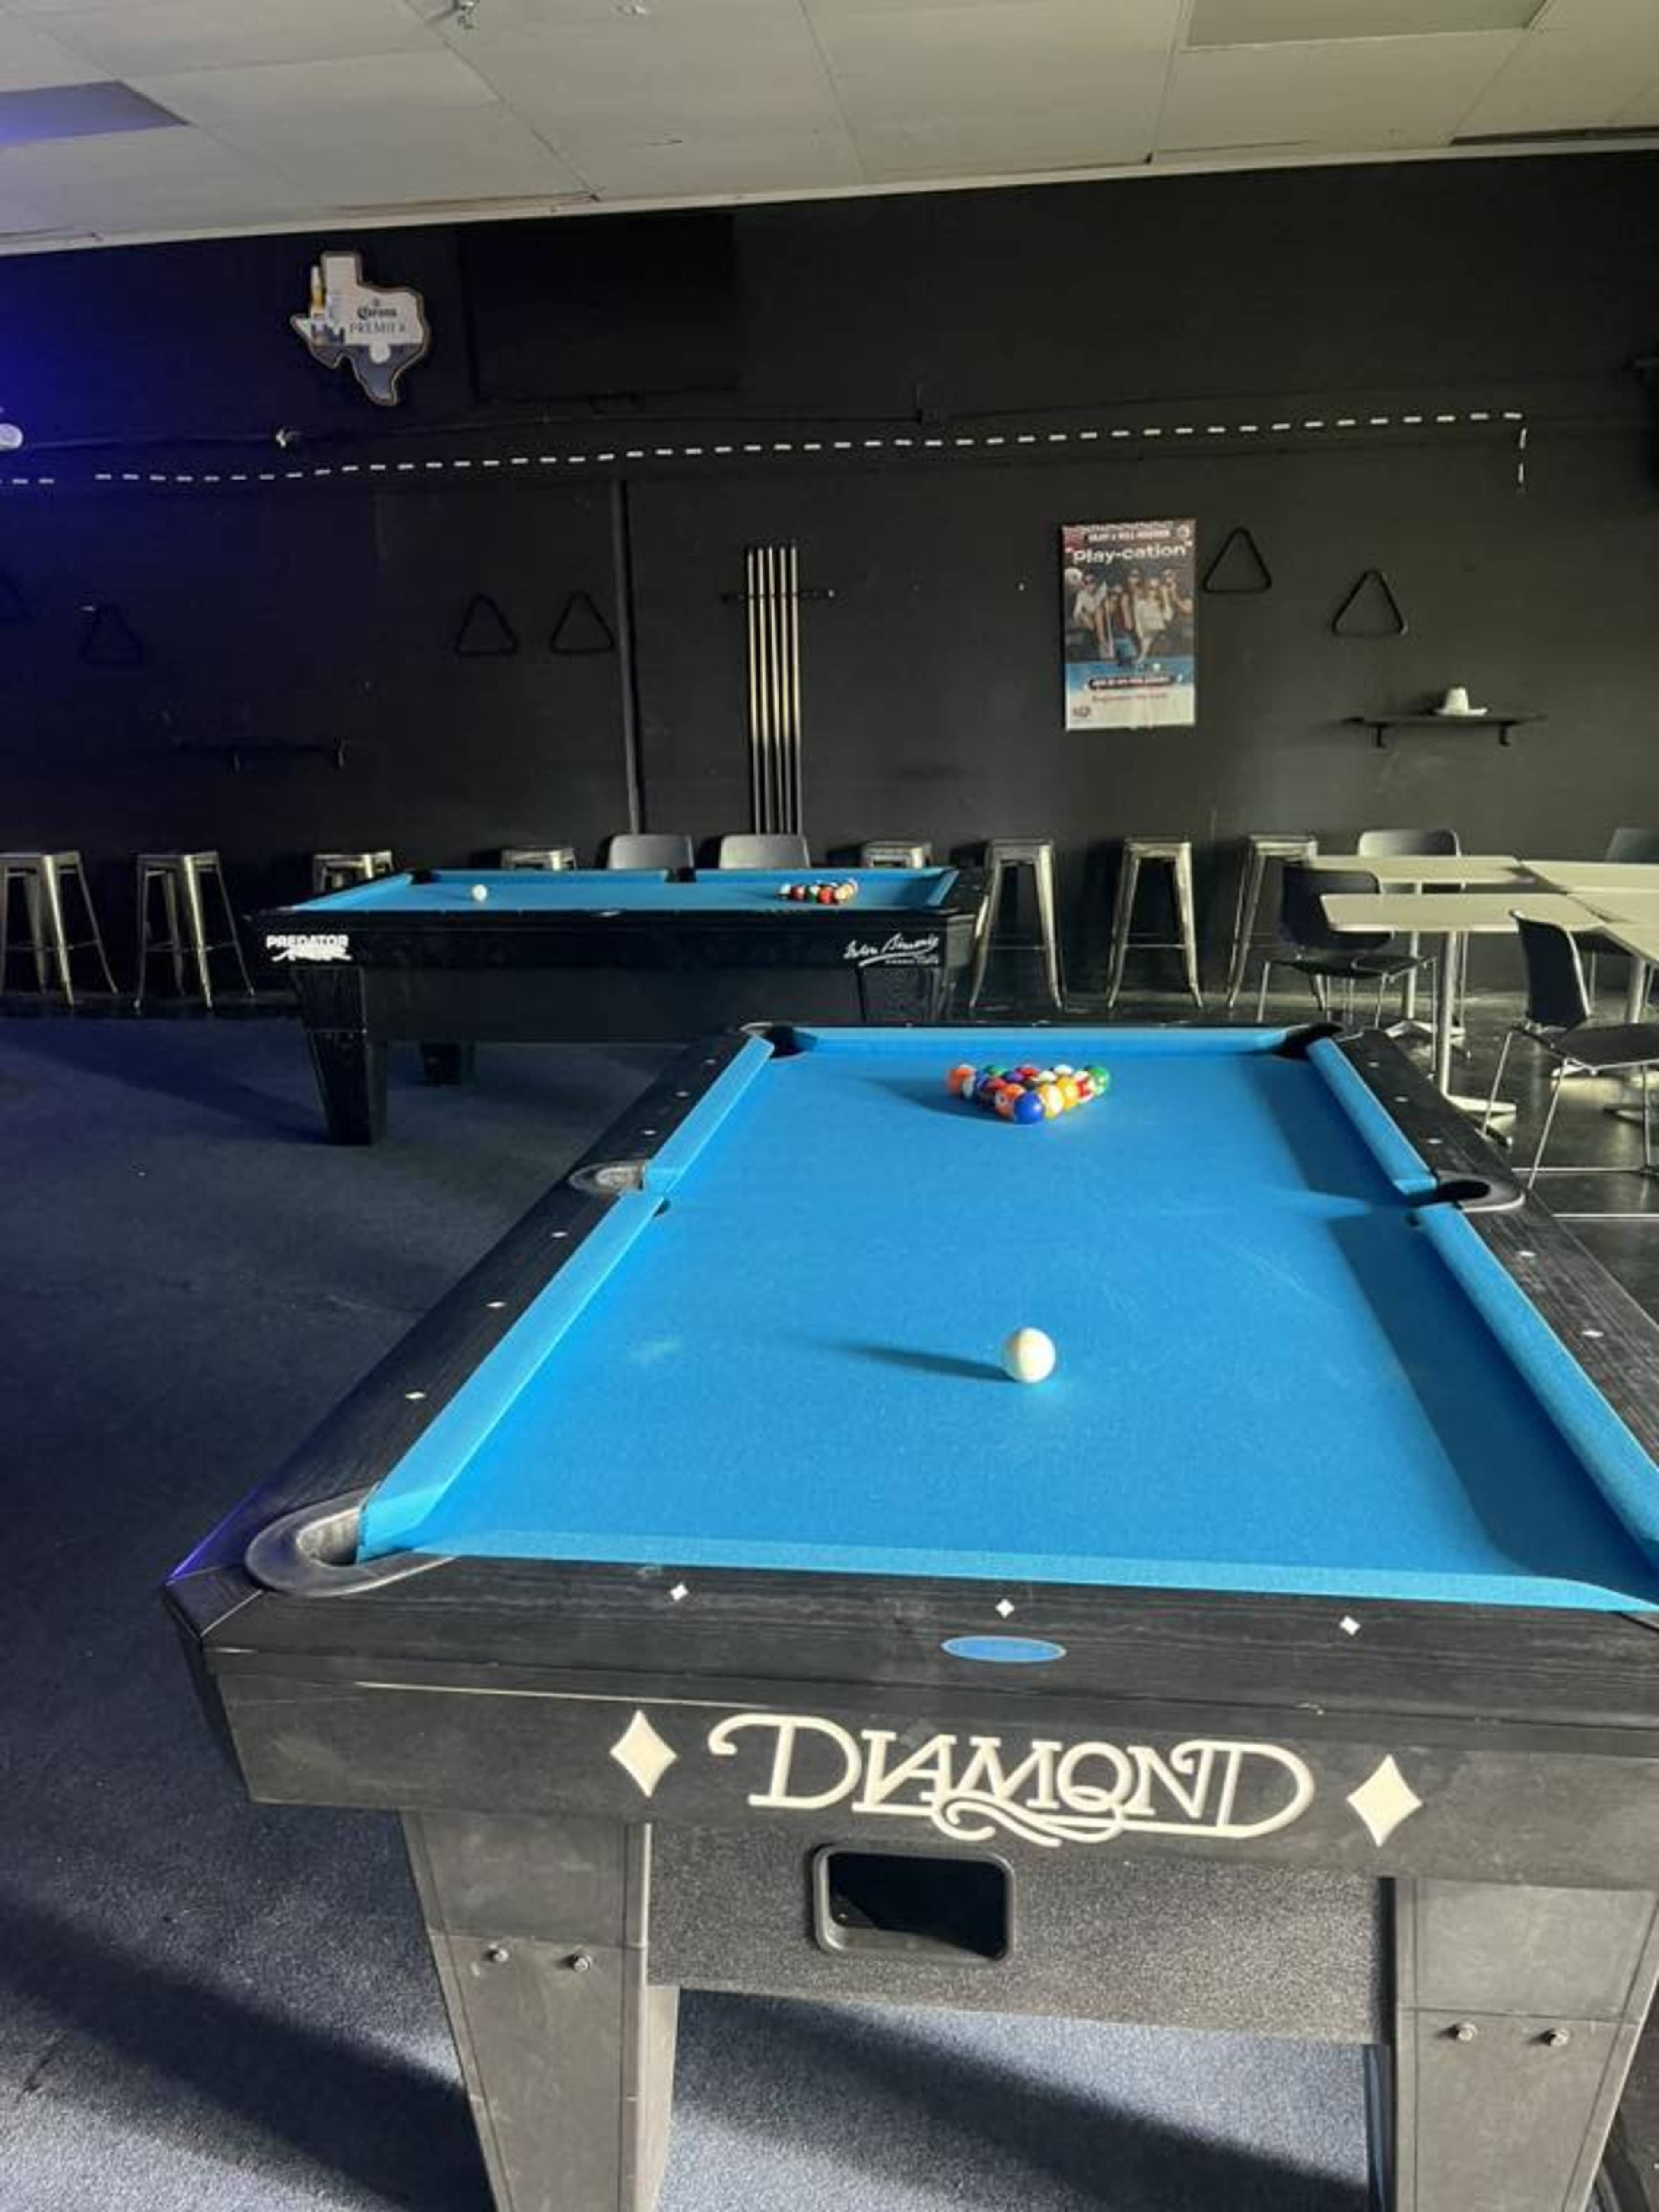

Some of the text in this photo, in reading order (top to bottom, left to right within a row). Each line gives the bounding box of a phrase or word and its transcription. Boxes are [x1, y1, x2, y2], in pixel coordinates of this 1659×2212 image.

[357, 307, 396, 320] Corona
[350, 322, 405, 332] PREMIER
[266, 934, 349, 949] PREDATOR
[708, 1713, 1316, 1847] DIAMOND
